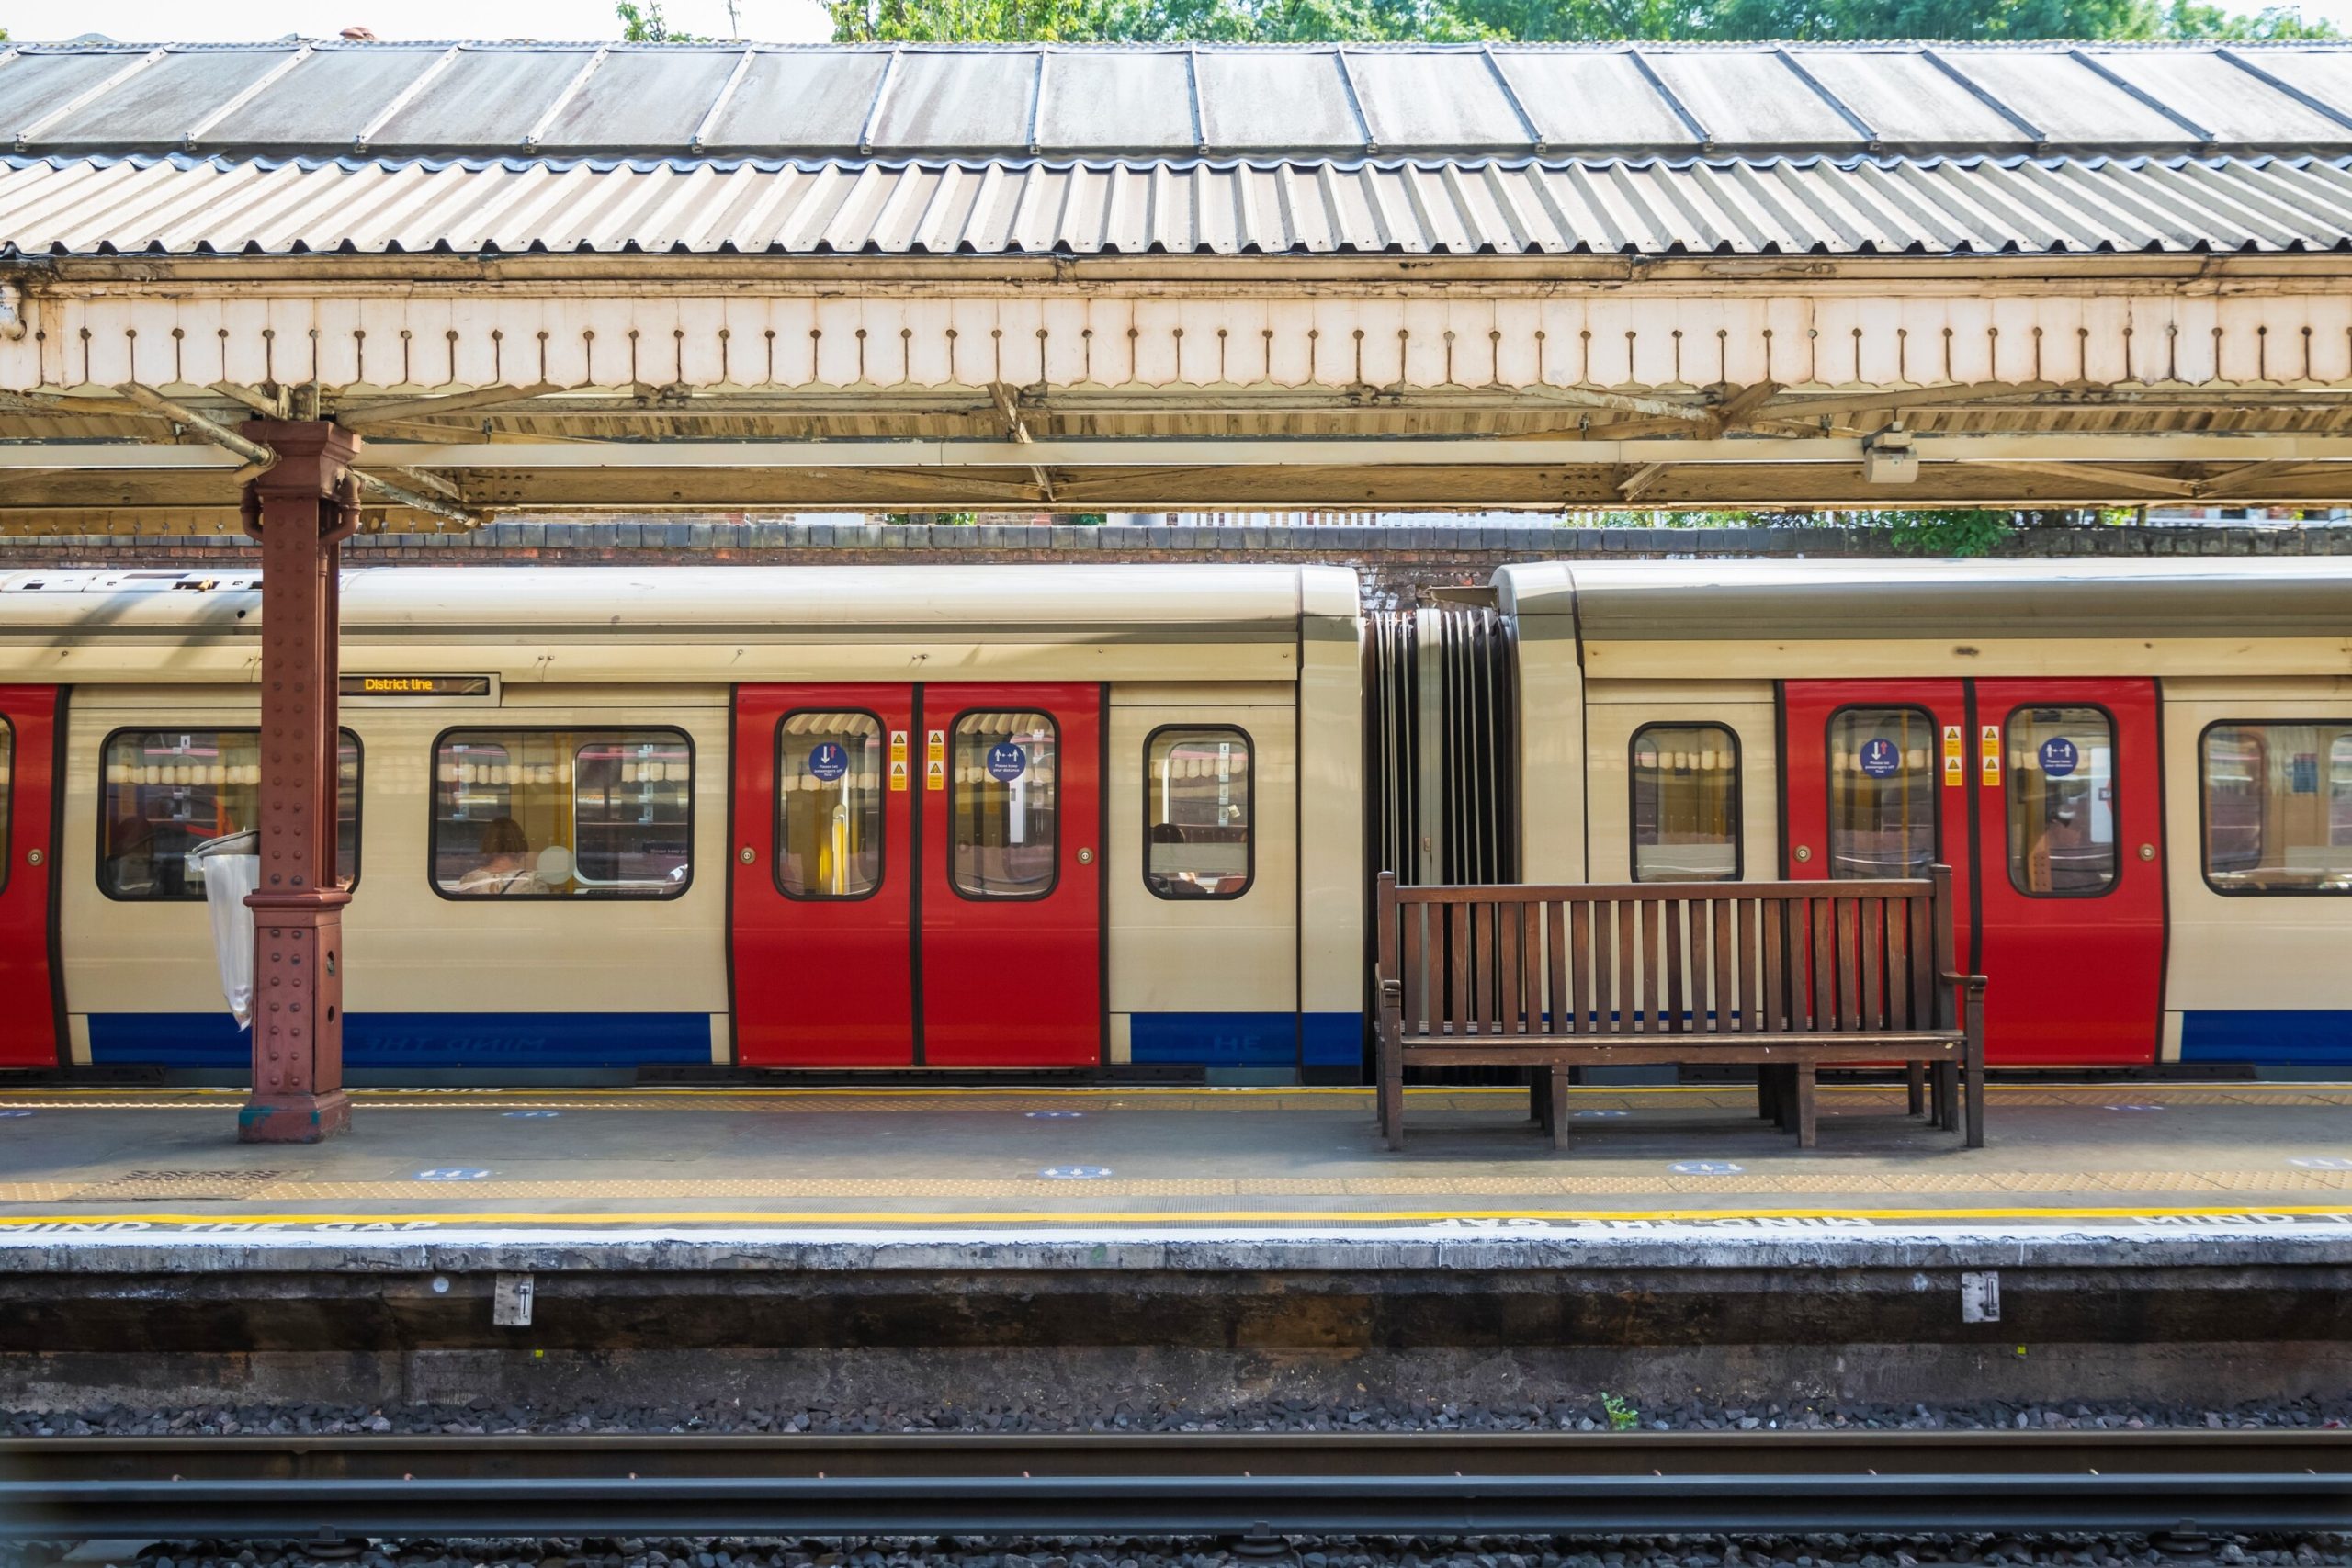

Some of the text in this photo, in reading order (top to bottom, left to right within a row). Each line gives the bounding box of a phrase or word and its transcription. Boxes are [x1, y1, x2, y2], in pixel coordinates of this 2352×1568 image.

[365, 679, 433, 690] District line
[2131, 1215, 2296, 1225] MIND
[181, 1223, 296, 1232] THE
[313, 1222, 441, 1232] GAP
